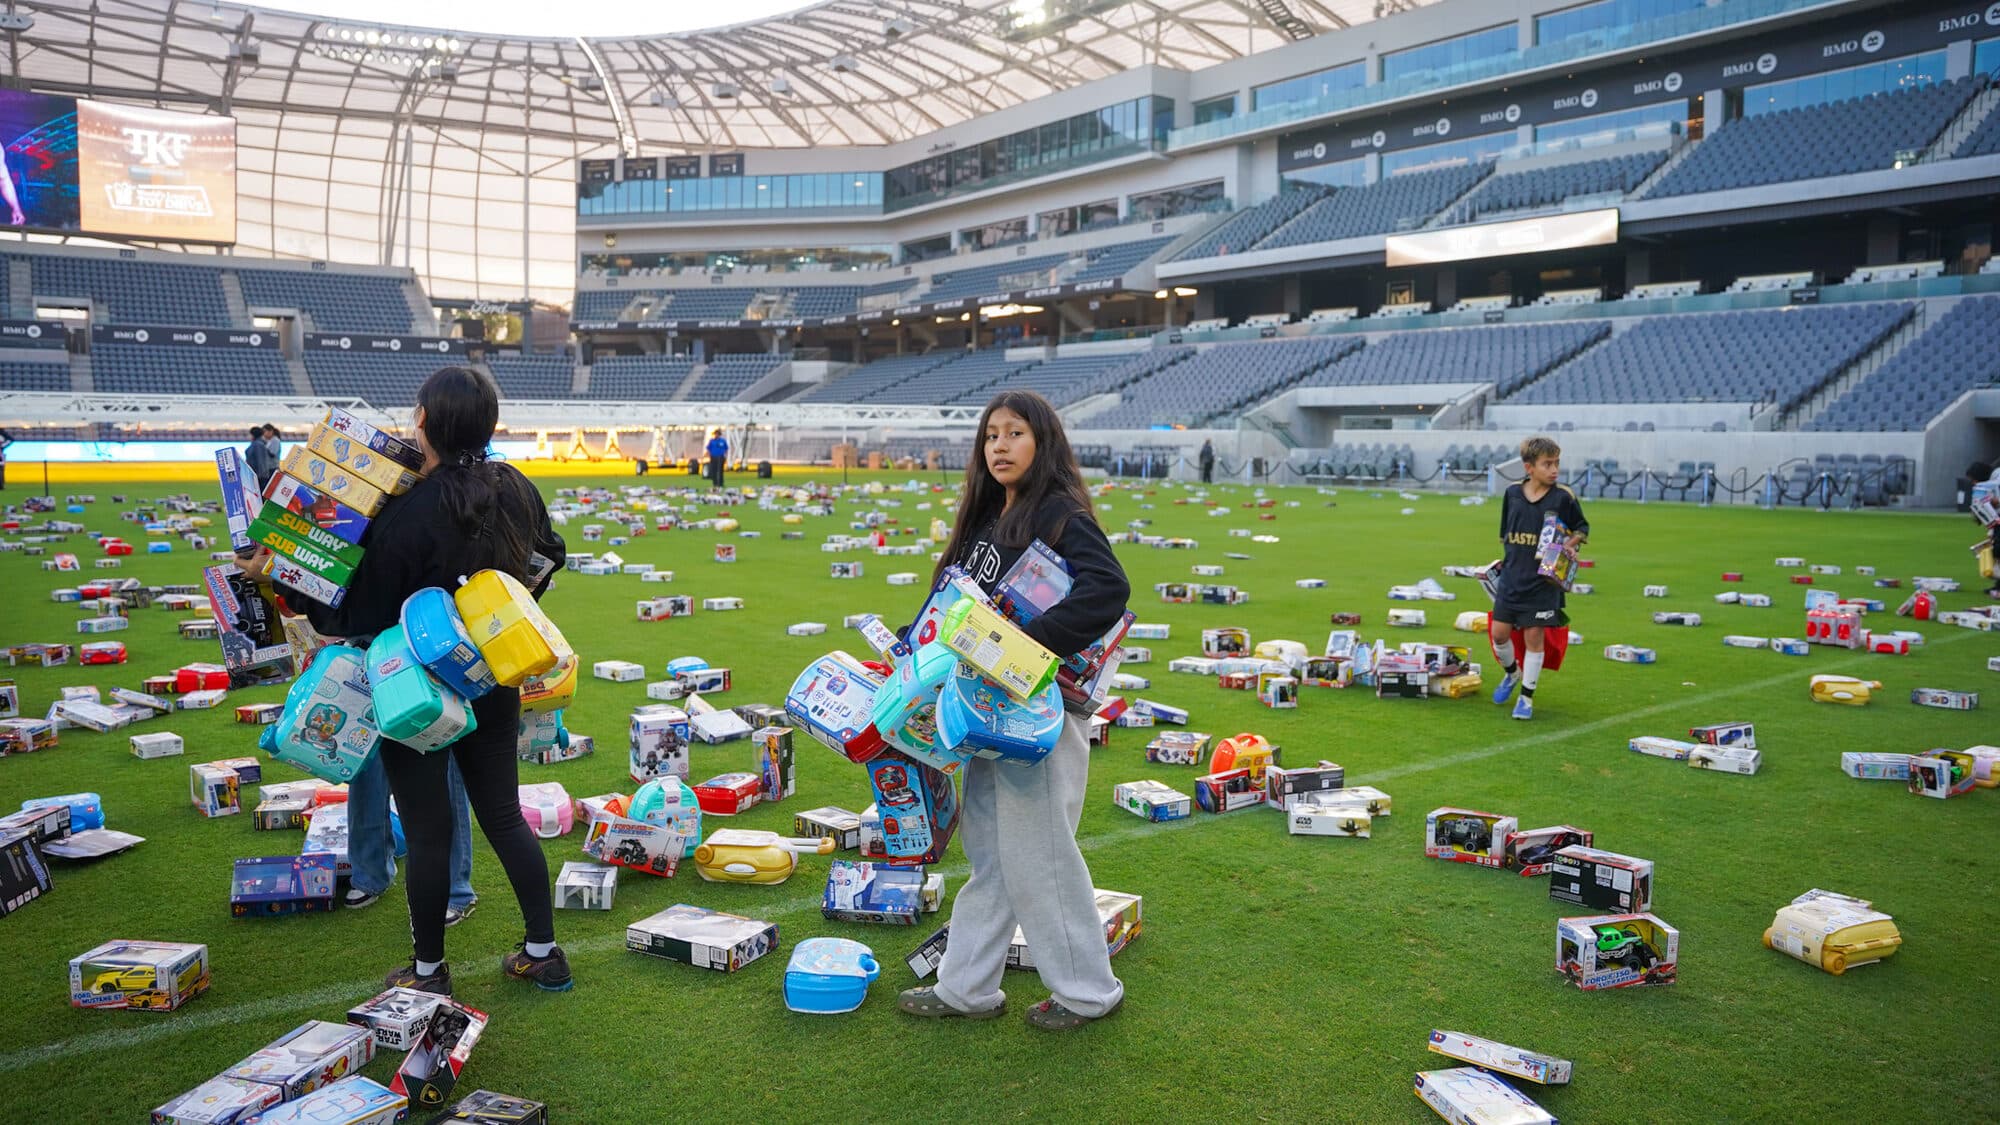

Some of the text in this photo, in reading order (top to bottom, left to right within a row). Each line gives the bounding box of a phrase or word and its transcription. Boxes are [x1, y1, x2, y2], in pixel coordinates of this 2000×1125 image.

[1939, 13, 1980, 32] BMO
[1822, 40, 1858, 57] BMO
[1722, 62, 1754, 77] BMO
[1634, 81, 1662, 95] BMO
[1553, 96, 1579, 110] BMO
[1480, 112, 1504, 124] BMO
[1413, 125, 1435, 137] BMO
[123, 127, 193, 167] TKF
[1351, 137, 1371, 149] BMO
[471, 300, 509, 314] Ford
[3, 327, 26, 335] BMO
[114, 331, 134, 339] BMO
[173, 333, 193, 342] BMO
[277, 513, 349, 552] SUBWAY
[263, 532, 335, 572] SUBWAY
[252, 597, 266, 620] POLICE
[523, 682, 546, 692] BBQ
[82, 996, 113, 1004] MUSTANG
[410, 1015, 430, 1030] STAR
[375, 1028, 402, 1038] WARS
[409, 1023, 428, 1039] WAR
[376, 1035, 402, 1045] STAR
